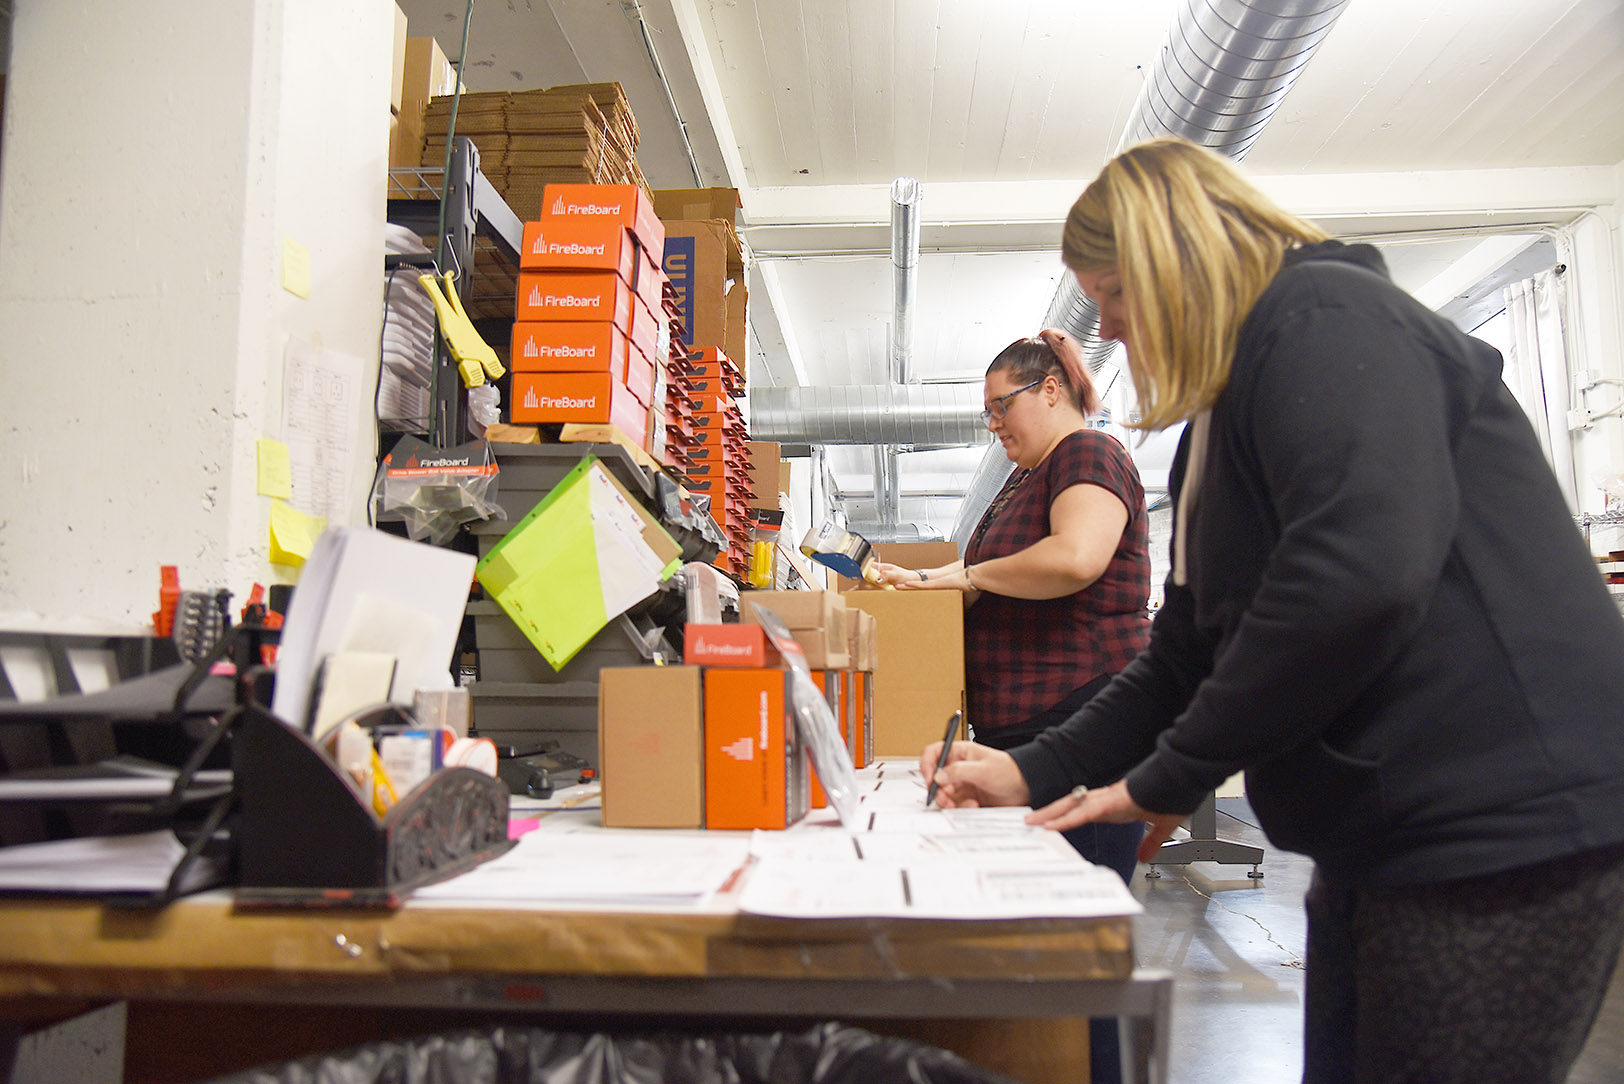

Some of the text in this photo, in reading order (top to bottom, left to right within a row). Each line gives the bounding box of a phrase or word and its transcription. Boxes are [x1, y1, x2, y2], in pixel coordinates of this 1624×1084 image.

[567, 203, 621, 215] FireBoard
[548, 242, 605, 256] FireBoard
[665, 254, 687, 329] ULI
[544, 294, 601, 307] FireBoard
[539, 345, 596, 358] FireBoard
[539, 396, 596, 409] FireBoard
[420, 457, 469, 468] FireBoard
